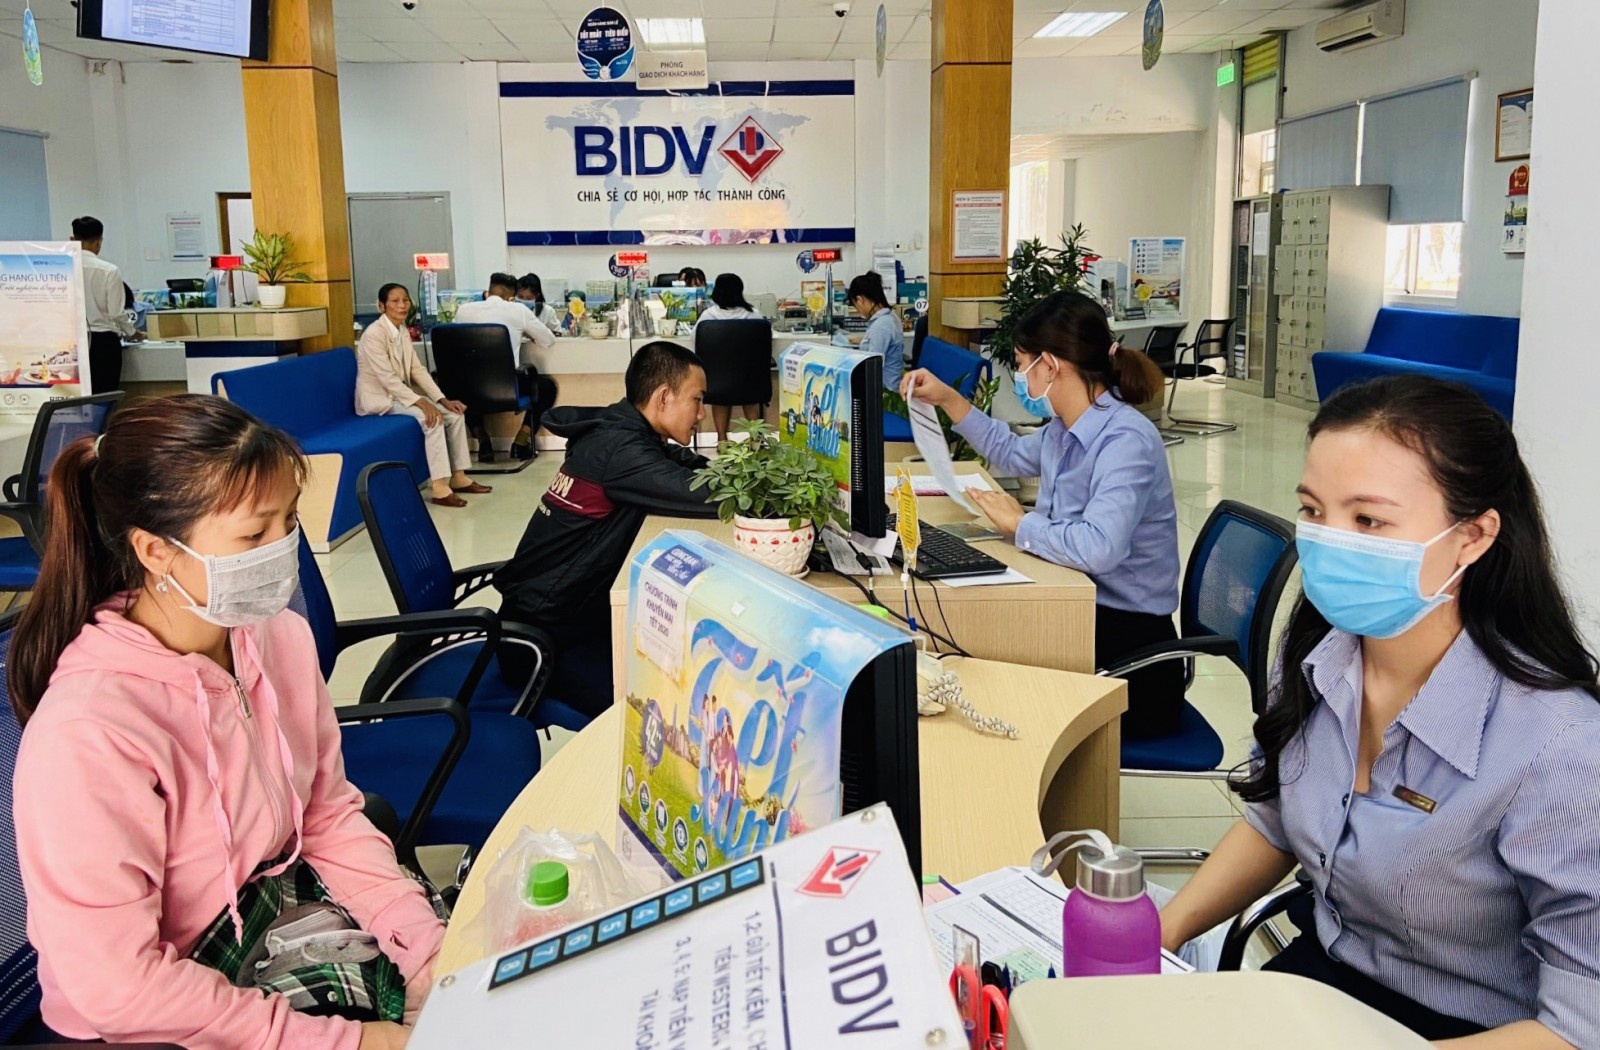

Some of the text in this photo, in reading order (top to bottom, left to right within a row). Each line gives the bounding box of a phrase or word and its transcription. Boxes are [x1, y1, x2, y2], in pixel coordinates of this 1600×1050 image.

[574, 125, 717, 177] BIDV
[577, 190, 600, 202] CHIA
[606, 187, 618, 202] SẺ
[624, 190, 638, 202] CƠ
[717, 188, 753, 201] THÀNH
[758, 187, 786, 201] CÔNG
[826, 919, 900, 1035] BIDV
